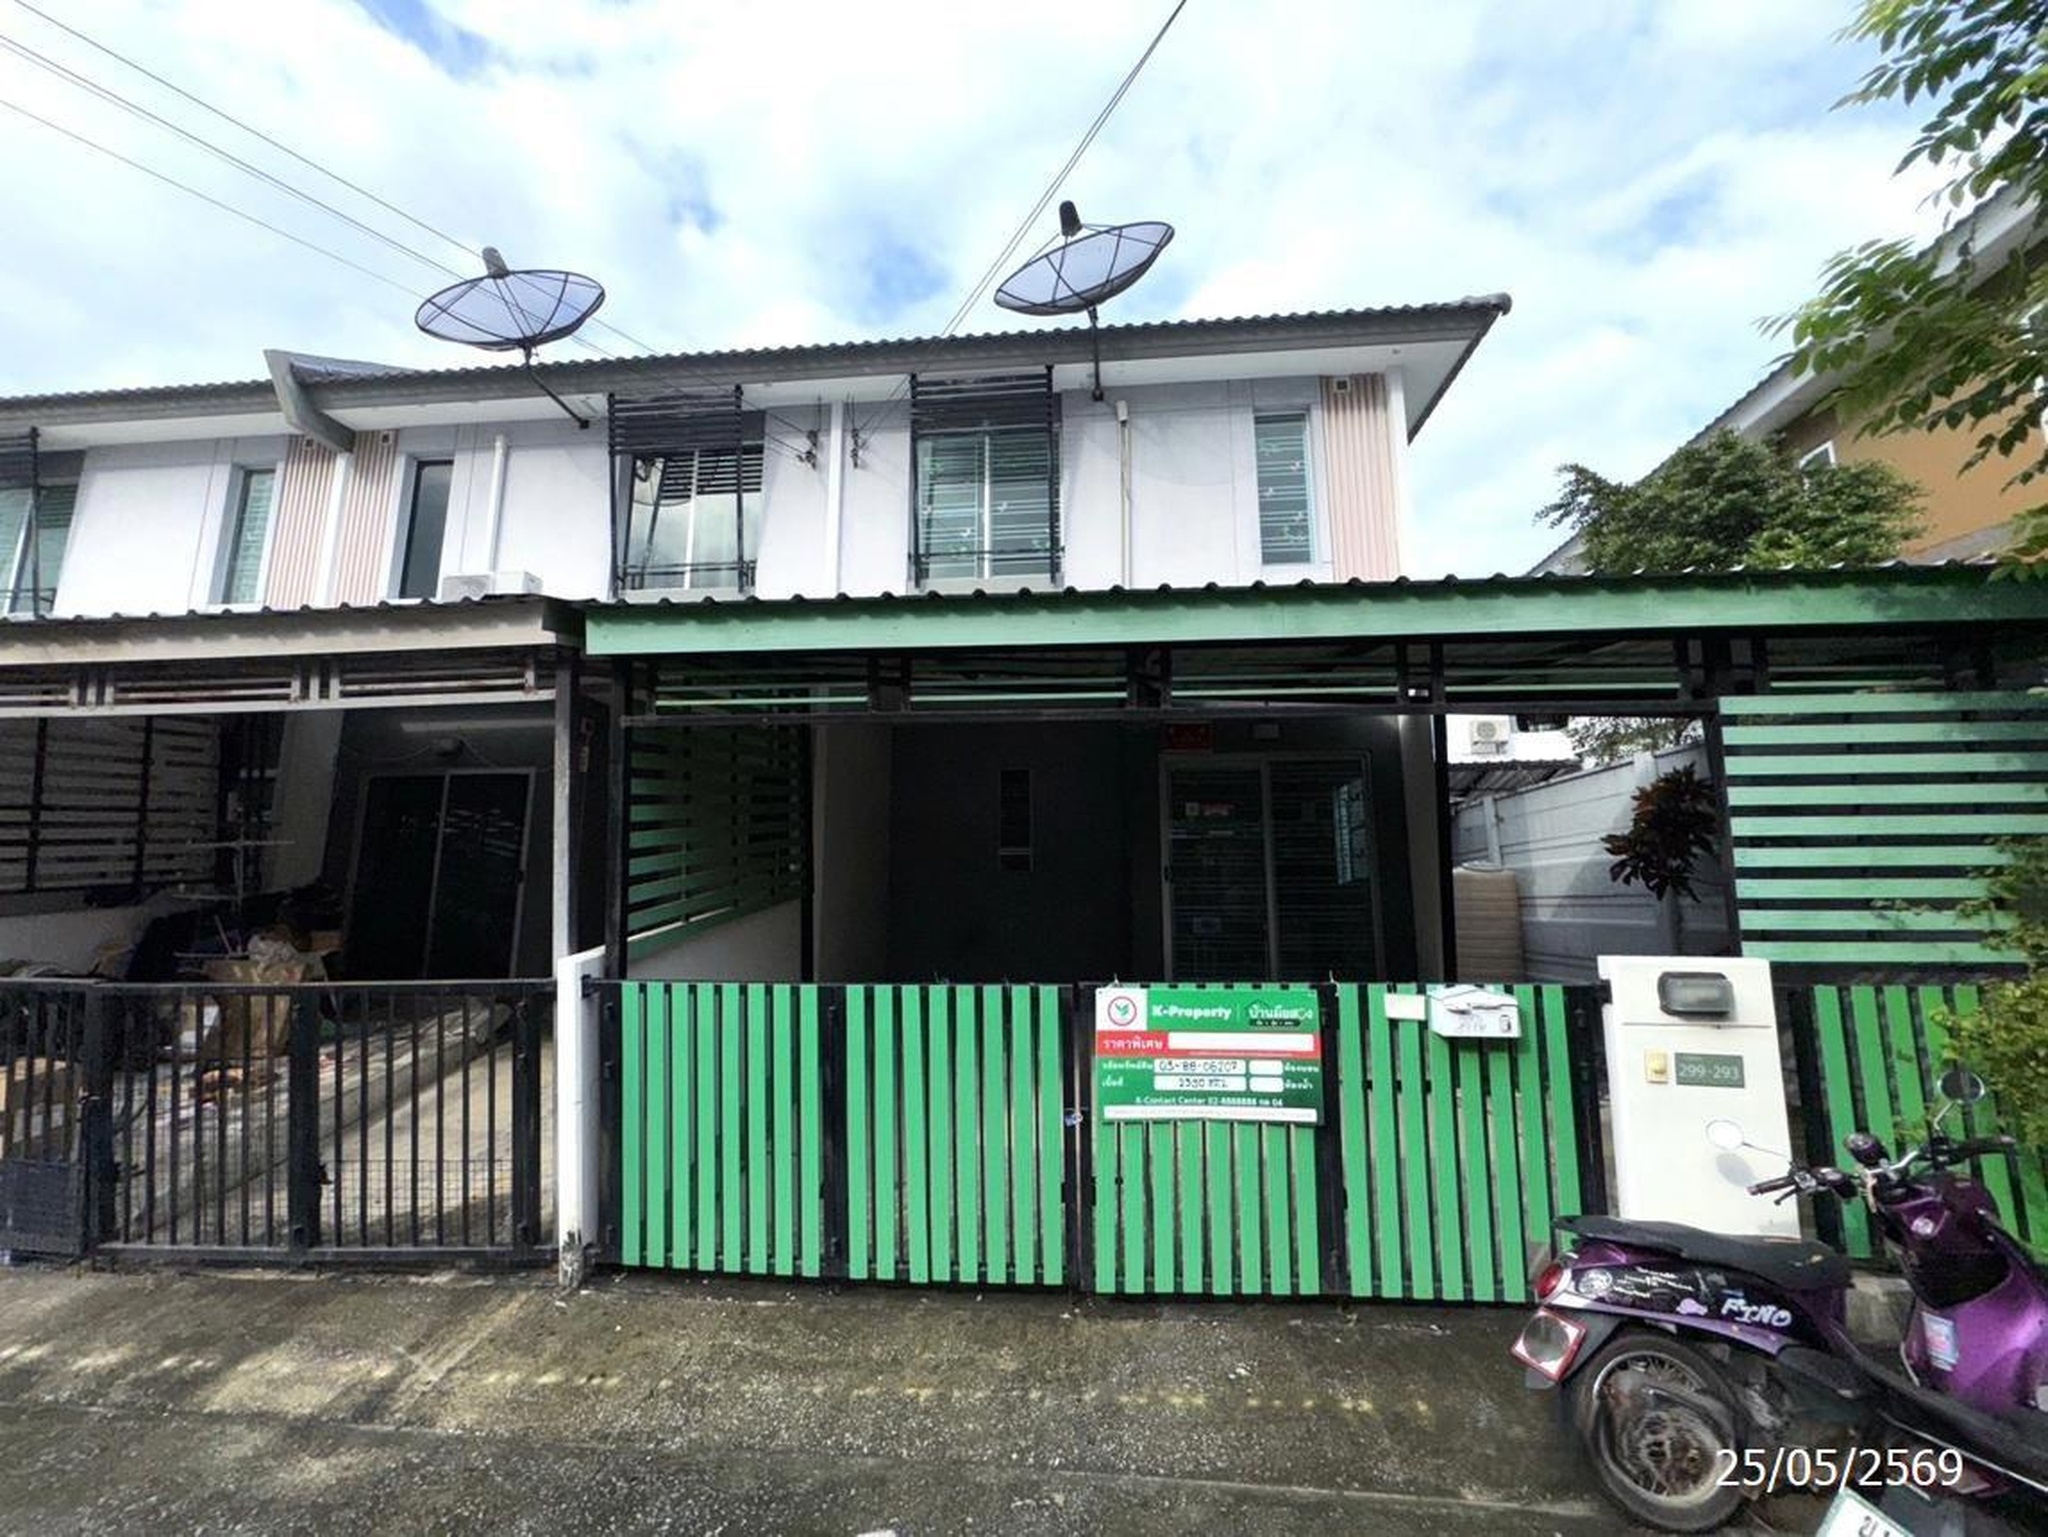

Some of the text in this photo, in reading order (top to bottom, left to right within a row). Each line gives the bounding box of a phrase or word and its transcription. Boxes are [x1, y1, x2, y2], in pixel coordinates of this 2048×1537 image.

[1152, 1004, 1232, 1020] K-Property
[1103, 1036, 1163, 1050] ราคาพิเศษ
[1178, 1096, 1207, 1105] Center
[1721, 1298, 1792, 1327] FINO
